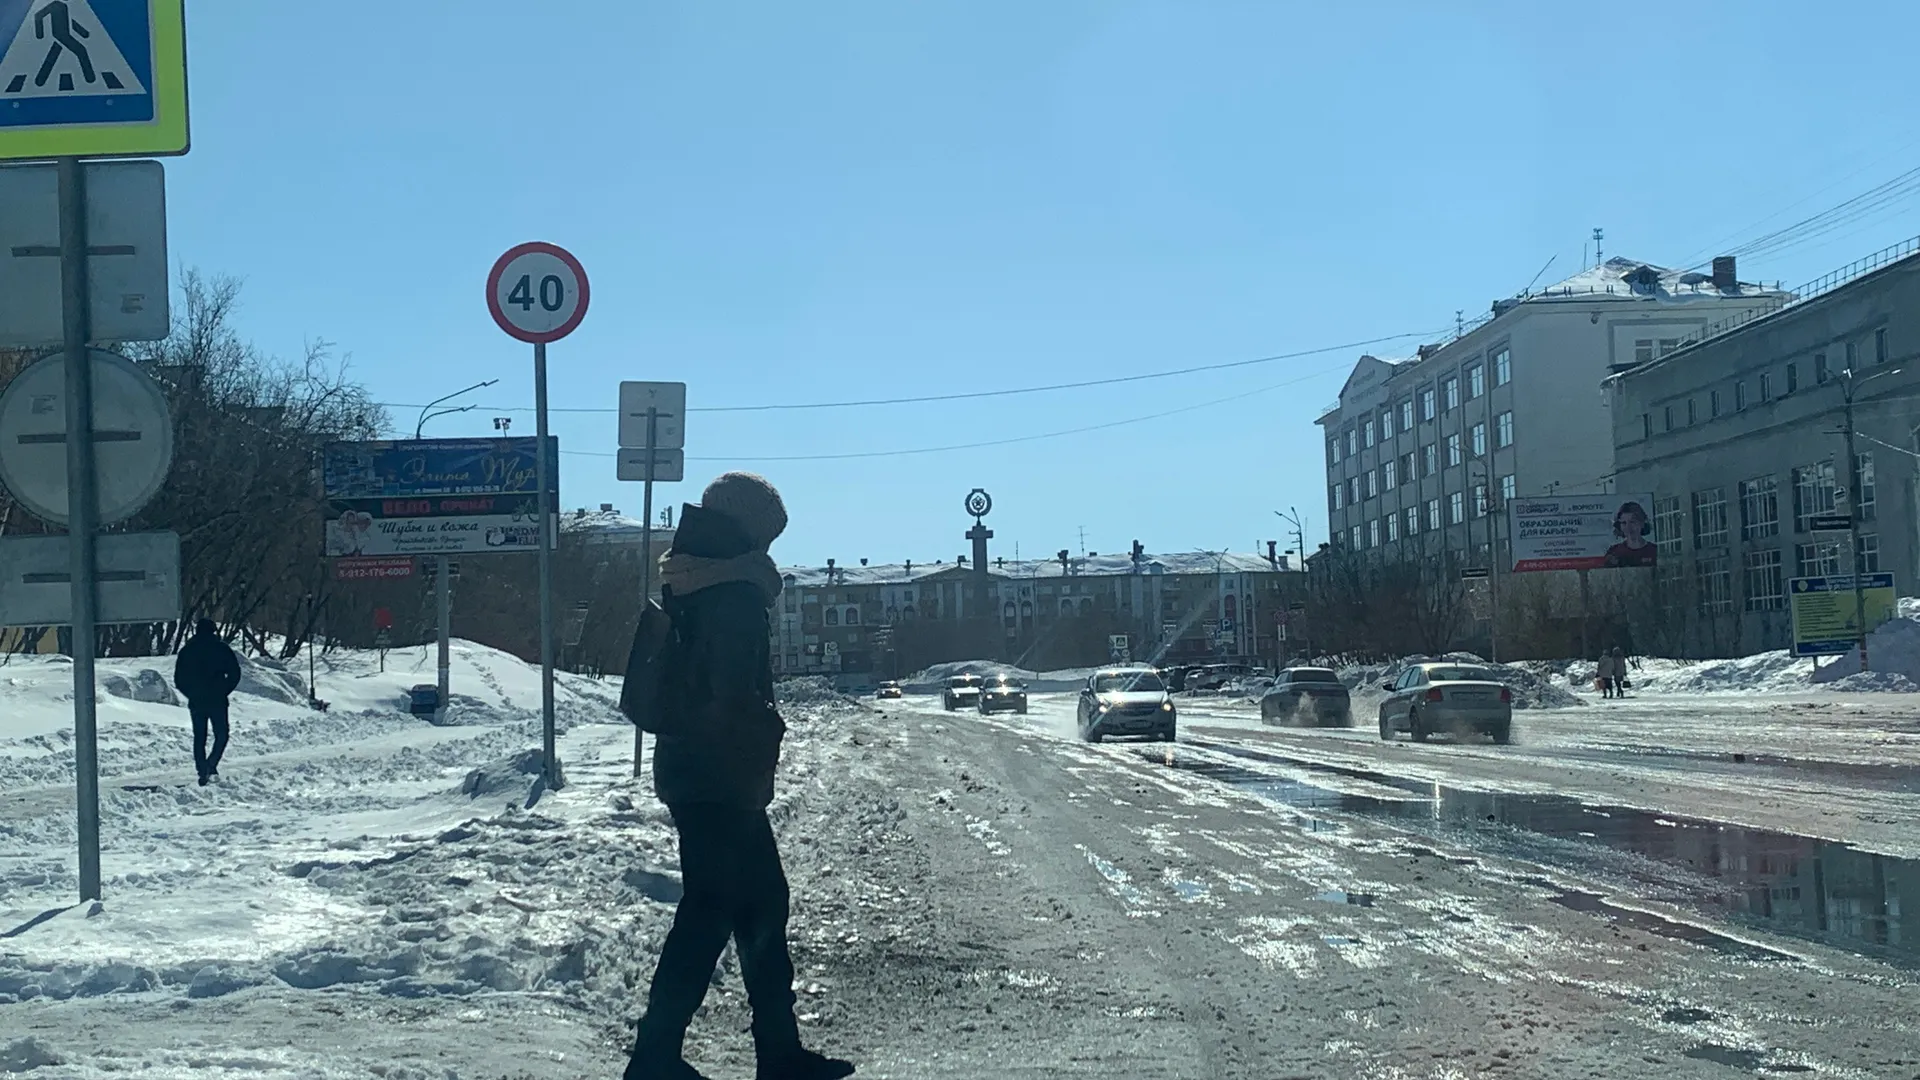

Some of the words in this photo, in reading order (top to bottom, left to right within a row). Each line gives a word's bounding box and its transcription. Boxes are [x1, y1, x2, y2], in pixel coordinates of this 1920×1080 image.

[507, 274, 564, 312] 40
[378, 519, 423, 536] Шубы
[427, 523, 437, 532] и
[440, 521, 480, 532] кожа
[1519, 519, 1583, 529] ОБРАЗОВАНИЕ
[1519, 528, 1539, 538] ДЛЯ
[1540, 527, 1579, 536] КАРЬЕРЫ
